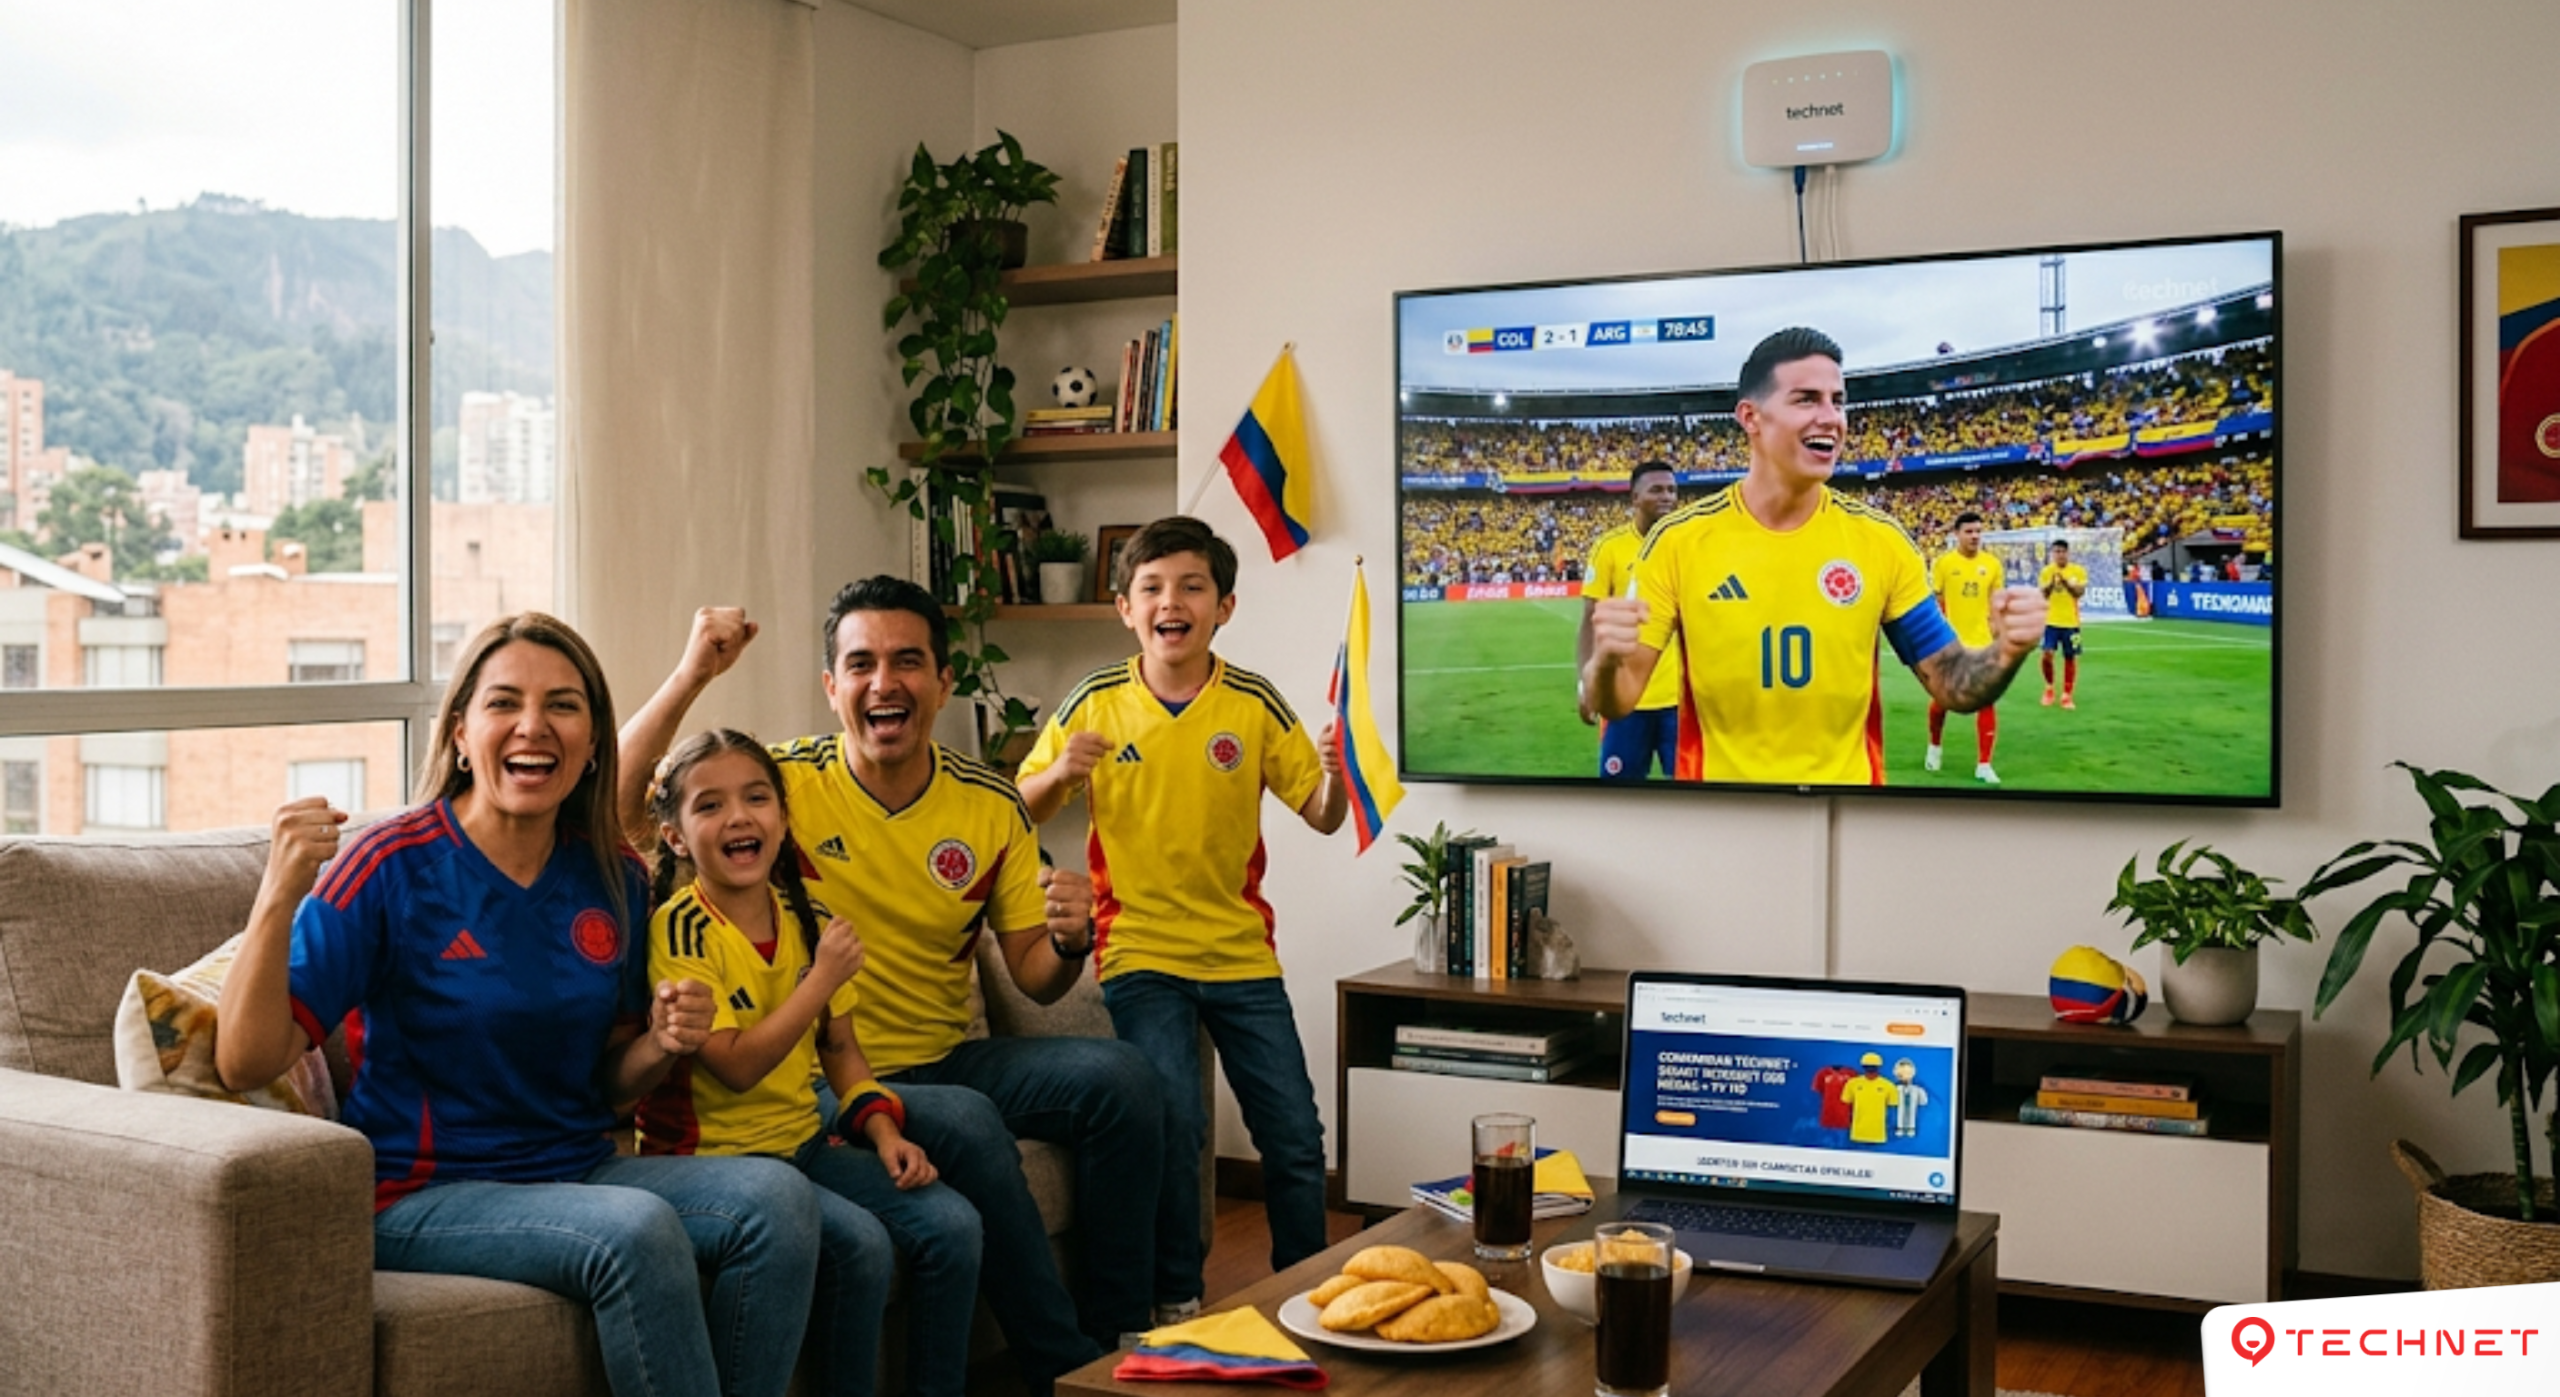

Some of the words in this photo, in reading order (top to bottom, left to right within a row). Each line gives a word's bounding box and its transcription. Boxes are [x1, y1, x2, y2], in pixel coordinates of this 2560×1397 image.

[1786, 102, 1844, 120] technet
[1497, 331, 1528, 347] COL
[1544, 330, 1553, 344] 2
[1593, 325, 1626, 341] ARG
[1762, 625, 1811, 688] 10
